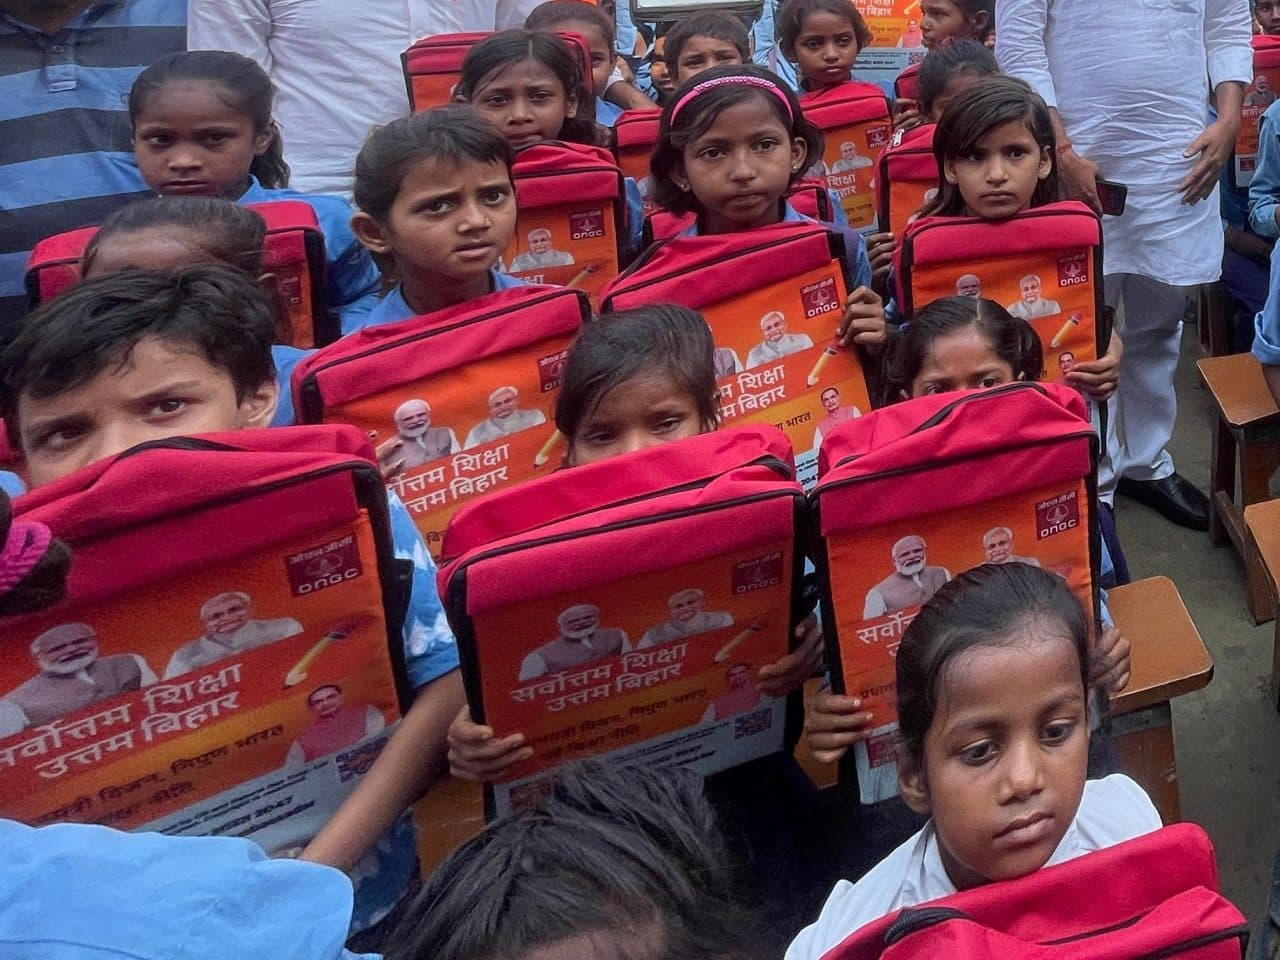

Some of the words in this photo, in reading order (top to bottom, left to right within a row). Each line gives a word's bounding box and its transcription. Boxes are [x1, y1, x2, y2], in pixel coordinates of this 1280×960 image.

[866, 7, 892, 16] बिहार
[826, 174, 856, 187] शिक्षा
[573, 227, 604, 239] ONGC
[1060, 274, 1087, 287] ONGC
[807, 301, 838, 318] ONGC
[738, 364, 785, 393] शिक्षा
[738, 385, 786, 414] बिहार
[785, 412, 811, 427] भारत
[451, 444, 510, 477] शिक्षा
[450, 467, 509, 500] बिहार
[1039, 518, 1077, 539] ONGC
[297, 568, 358, 595] ONGC
[510, 662, 611, 703] सर्वोत्तम
[620, 642, 688, 674] शिक्षा
[142, 662, 243, 713] शिक्षा
[546, 682, 612, 712] उत्तम
[615, 662, 684, 694] बिहार
[35, 730, 134, 779] उत्तम
[140, 692, 241, 743] बिहार
